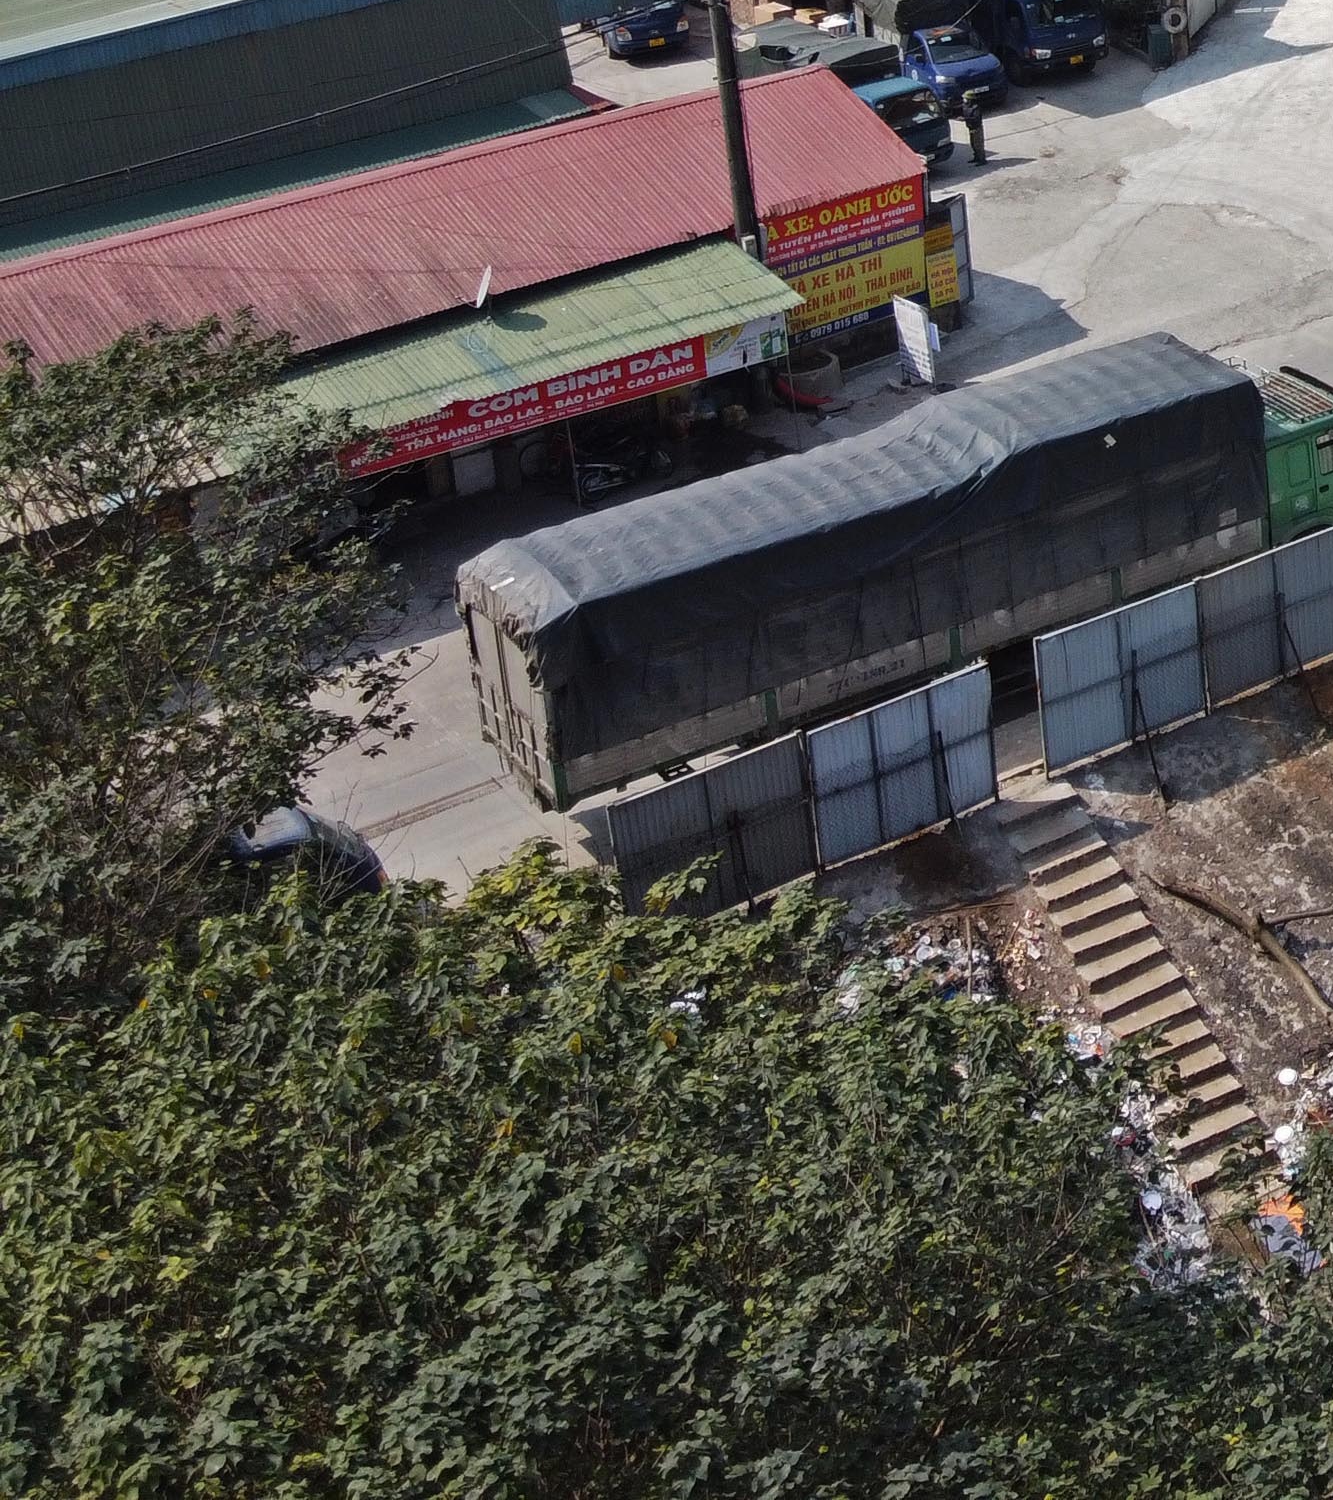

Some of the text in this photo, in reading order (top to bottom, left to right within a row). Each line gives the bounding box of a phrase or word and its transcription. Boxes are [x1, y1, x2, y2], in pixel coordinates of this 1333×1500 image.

[819, 196, 872, 226] OANH
[876, 183, 914, 209] ƯỚC
[779, 233, 812, 250] TUYẾN
[830, 224, 849, 237] NỘI
[862, 214, 880, 226] HẢI
[882, 203, 916, 221] PHÒNG
[812, 273, 831, 288] XE
[835, 262, 856, 283] HÀ
[822, 290, 838, 307] HÀ
[838, 284, 857, 304] NỘI
[889, 266, 914, 286] BÌNH
[810, 323, 834, 340] 0979
[467, 344, 694, 419] CƠM BÌNH DÂN
[405, 432, 435, 452] TRẢ
[437, 422, 483, 444] HÀNG:
[485, 412, 515, 430] BẢO
[555, 393, 584, 411] BẢO
[587, 383, 617, 402] LÂM
[627, 375, 655, 390] CAO
[657, 362, 696, 382] BẰNG
